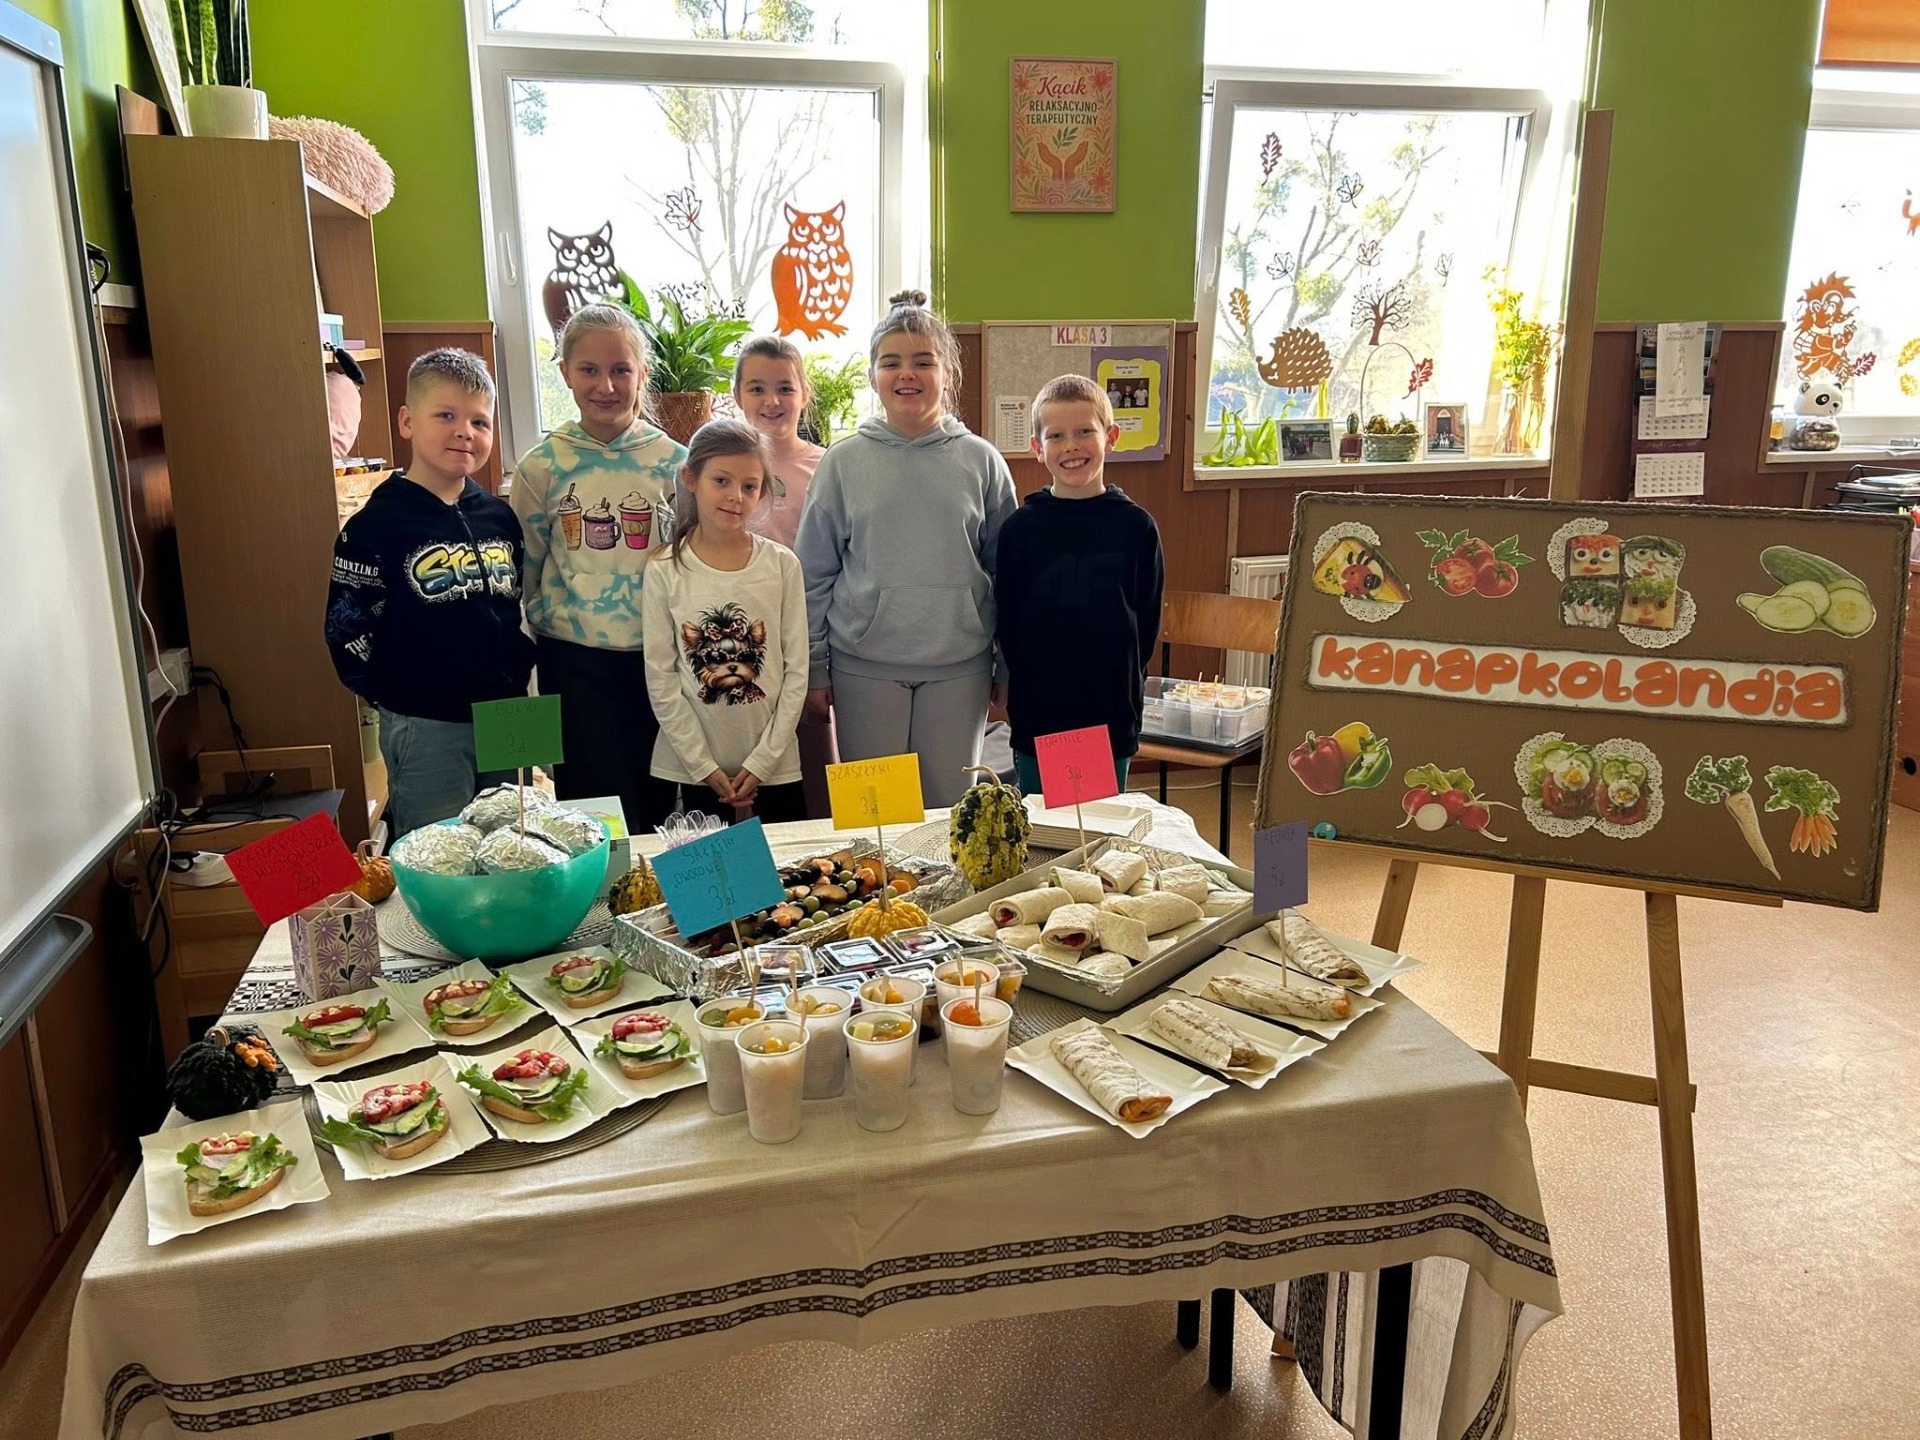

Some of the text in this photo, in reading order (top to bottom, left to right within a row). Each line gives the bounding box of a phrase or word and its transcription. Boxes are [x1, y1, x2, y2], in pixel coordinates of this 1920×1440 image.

[1036, 75, 1087, 99] Kącik
[1029, 100, 1101, 113] RELAKSACYJNO-
[1026, 114, 1098, 126] TERAPEUTYCZNY
[1056, 326, 1107, 345] KLASA 3
[1642, 328, 1658, 336] 202
